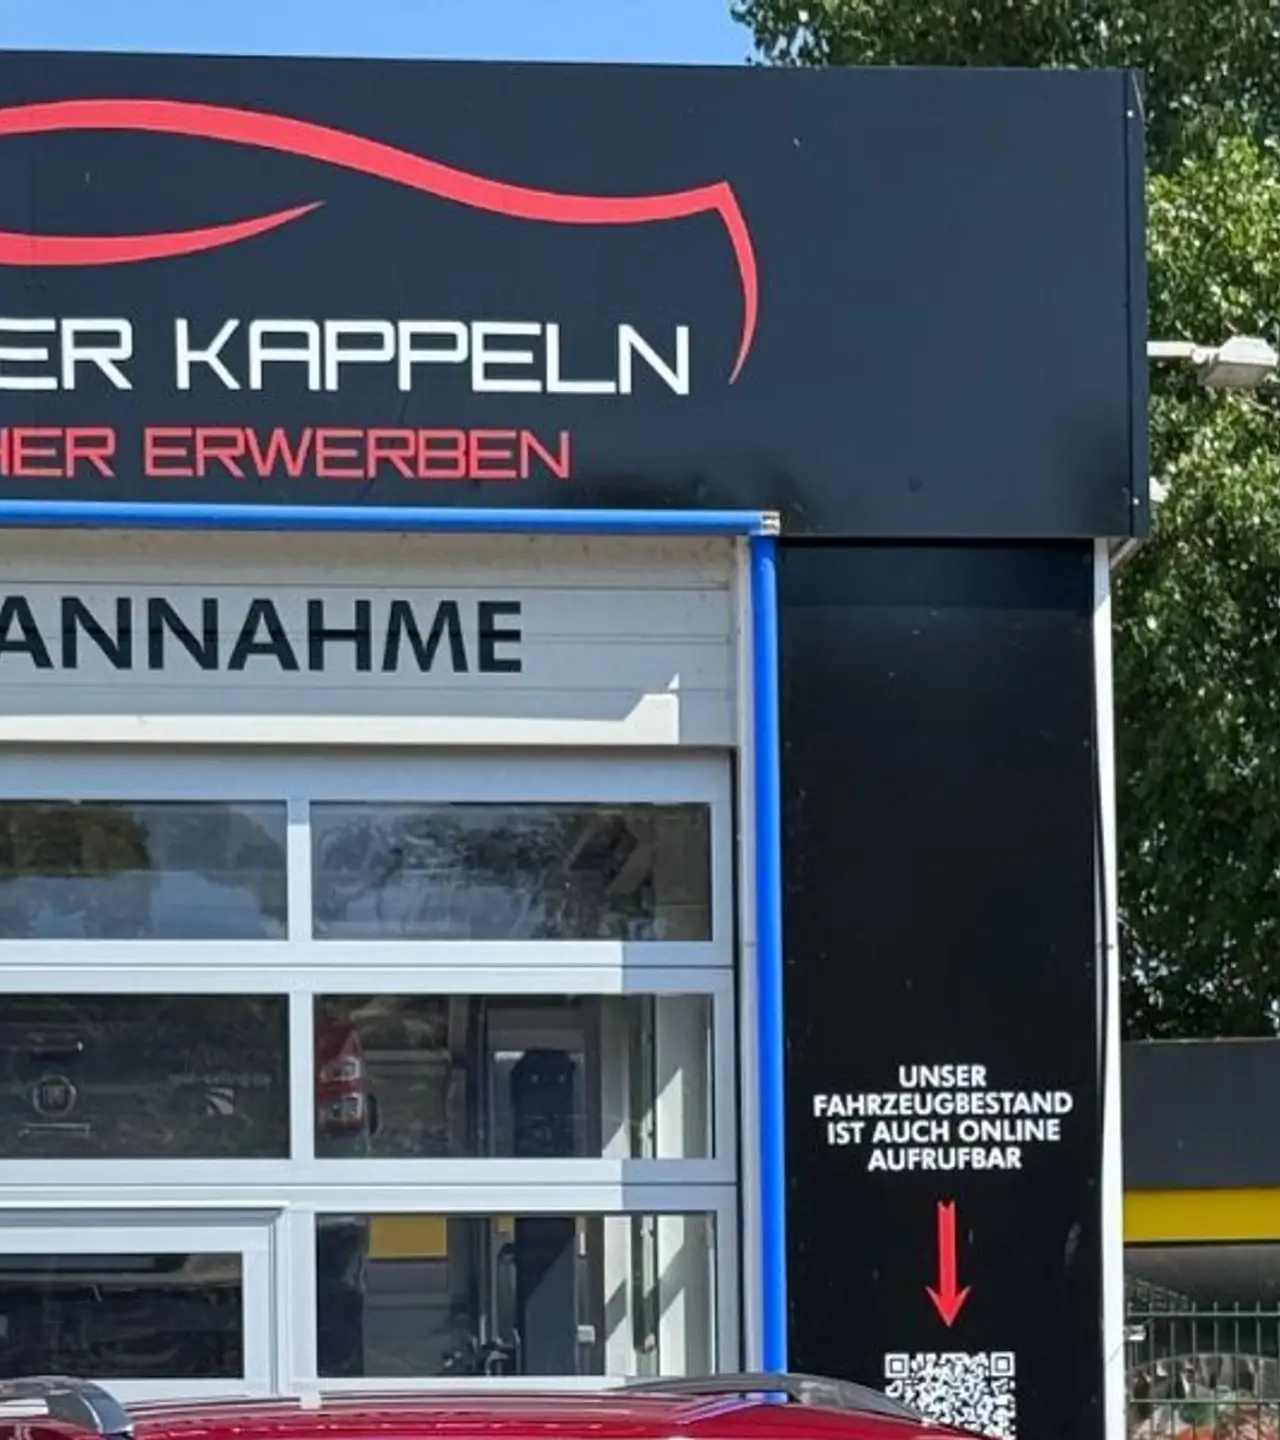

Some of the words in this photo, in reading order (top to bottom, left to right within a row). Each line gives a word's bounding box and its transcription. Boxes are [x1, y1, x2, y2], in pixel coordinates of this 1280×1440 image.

[175, 318, 689, 395] KAPPELN
[142, 425, 571, 481] ERWERBEN
[899, 1064, 987, 1088] UNSER
[813, 1091, 1073, 1117] FAHRZEUGBESTAND
[827, 1121, 865, 1145] IST
[872, 1119, 950, 1144] AUCH
[958, 1118, 1060, 1142] ONLINE
[867, 1146, 1022, 1171] AUFRUFBAR
